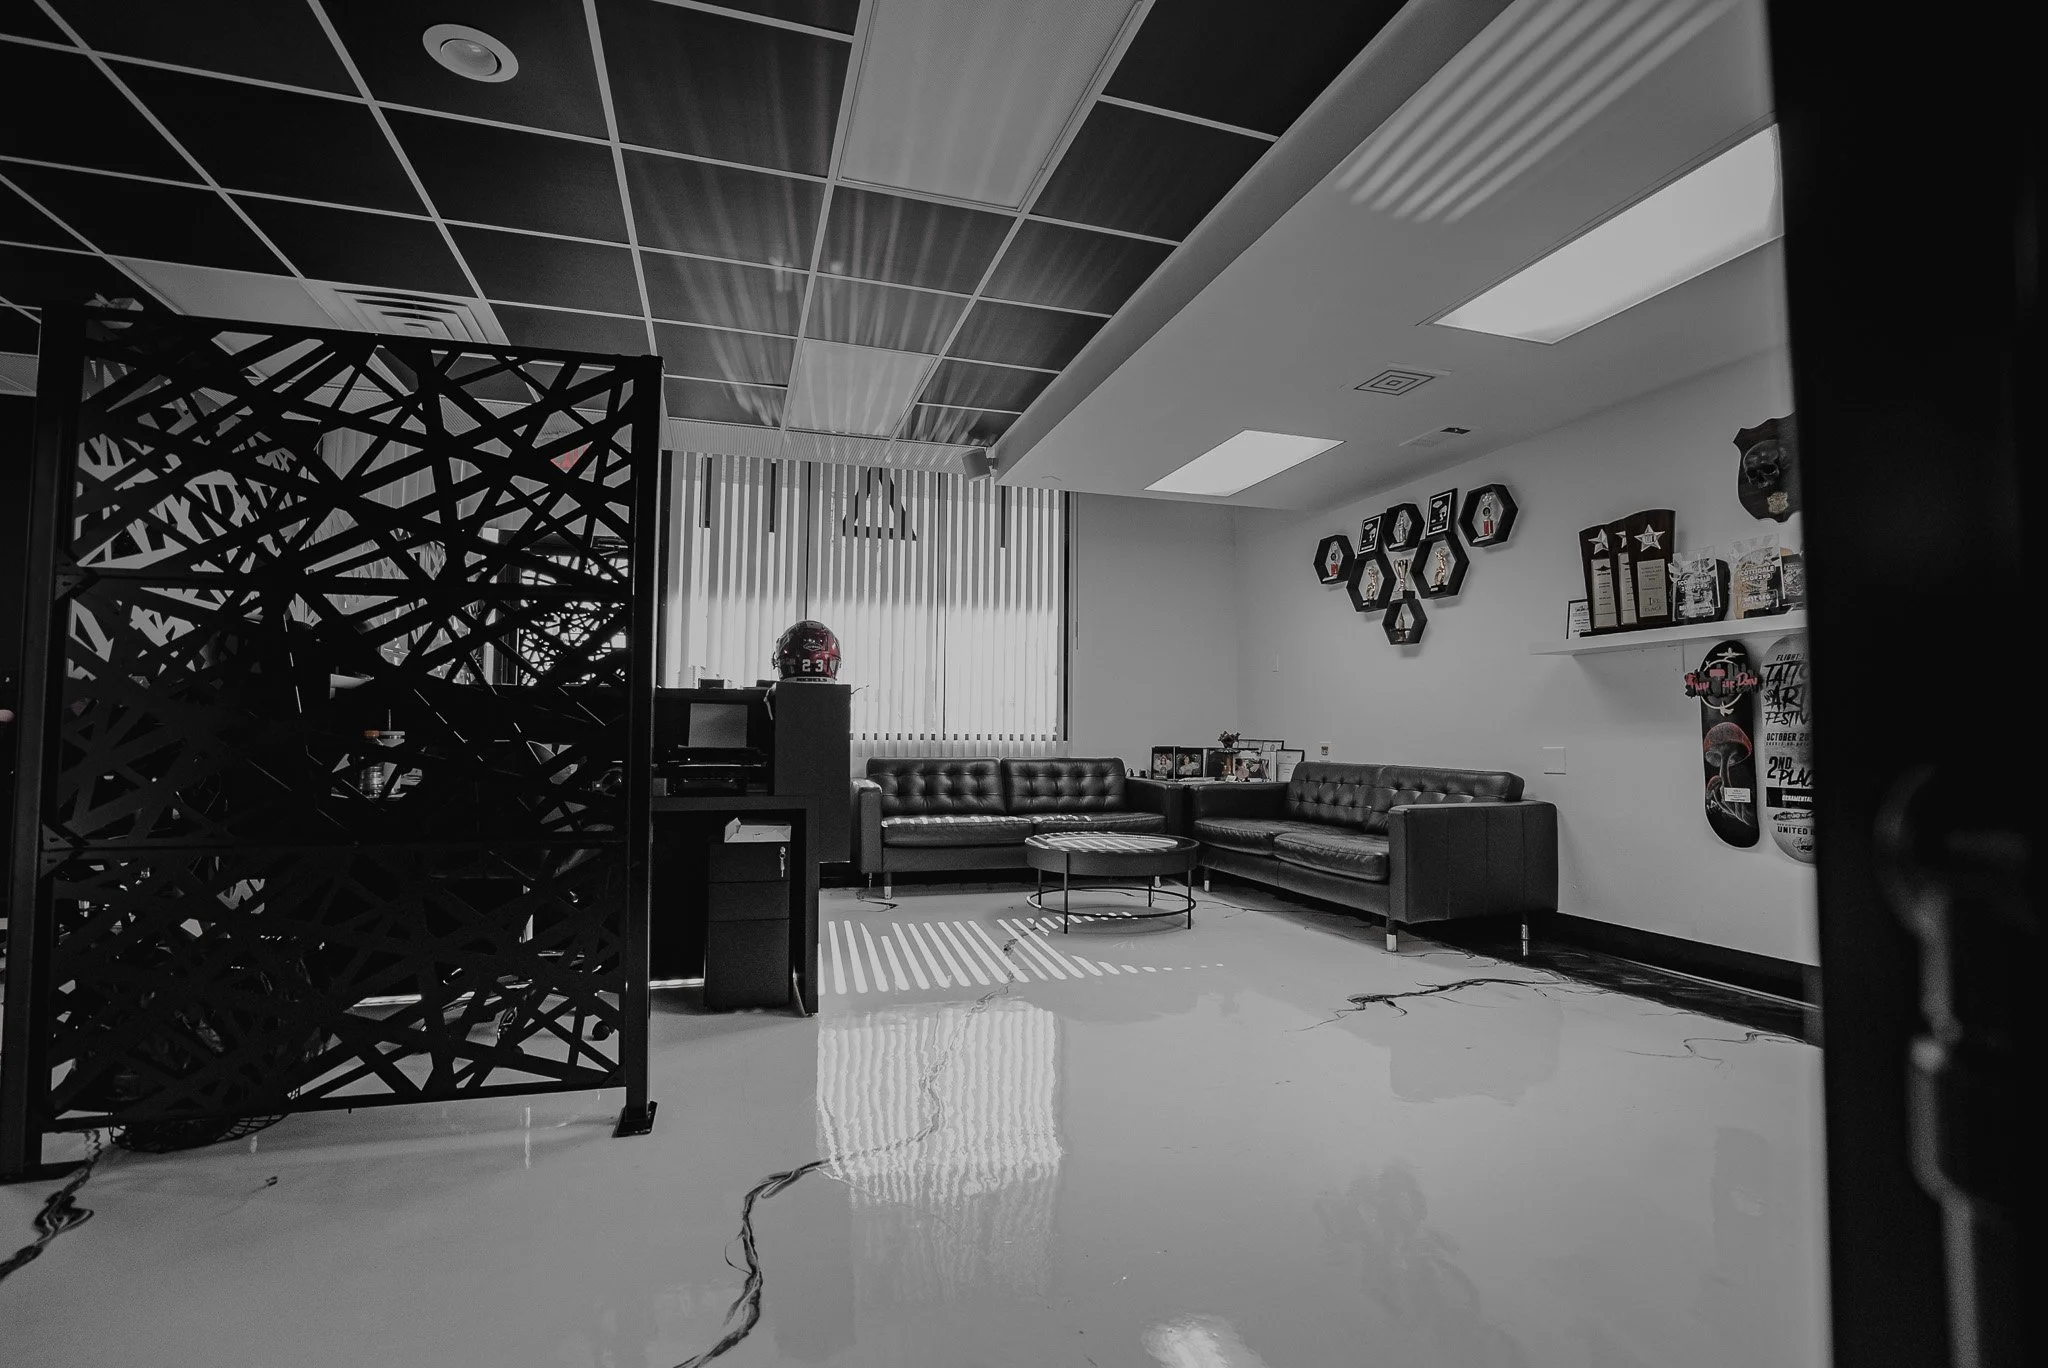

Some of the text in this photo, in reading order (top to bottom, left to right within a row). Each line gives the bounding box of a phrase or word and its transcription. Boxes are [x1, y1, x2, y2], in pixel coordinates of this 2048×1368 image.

[802, 659, 824, 672] 23
[1765, 711, 1810, 727] FESTIV
[1766, 733, 1797, 741] OCTOBER
[1767, 756, 1792, 779] 2ND
[1778, 768, 1816, 787] PLAC
[1777, 826, 1808, 835] UNITED
